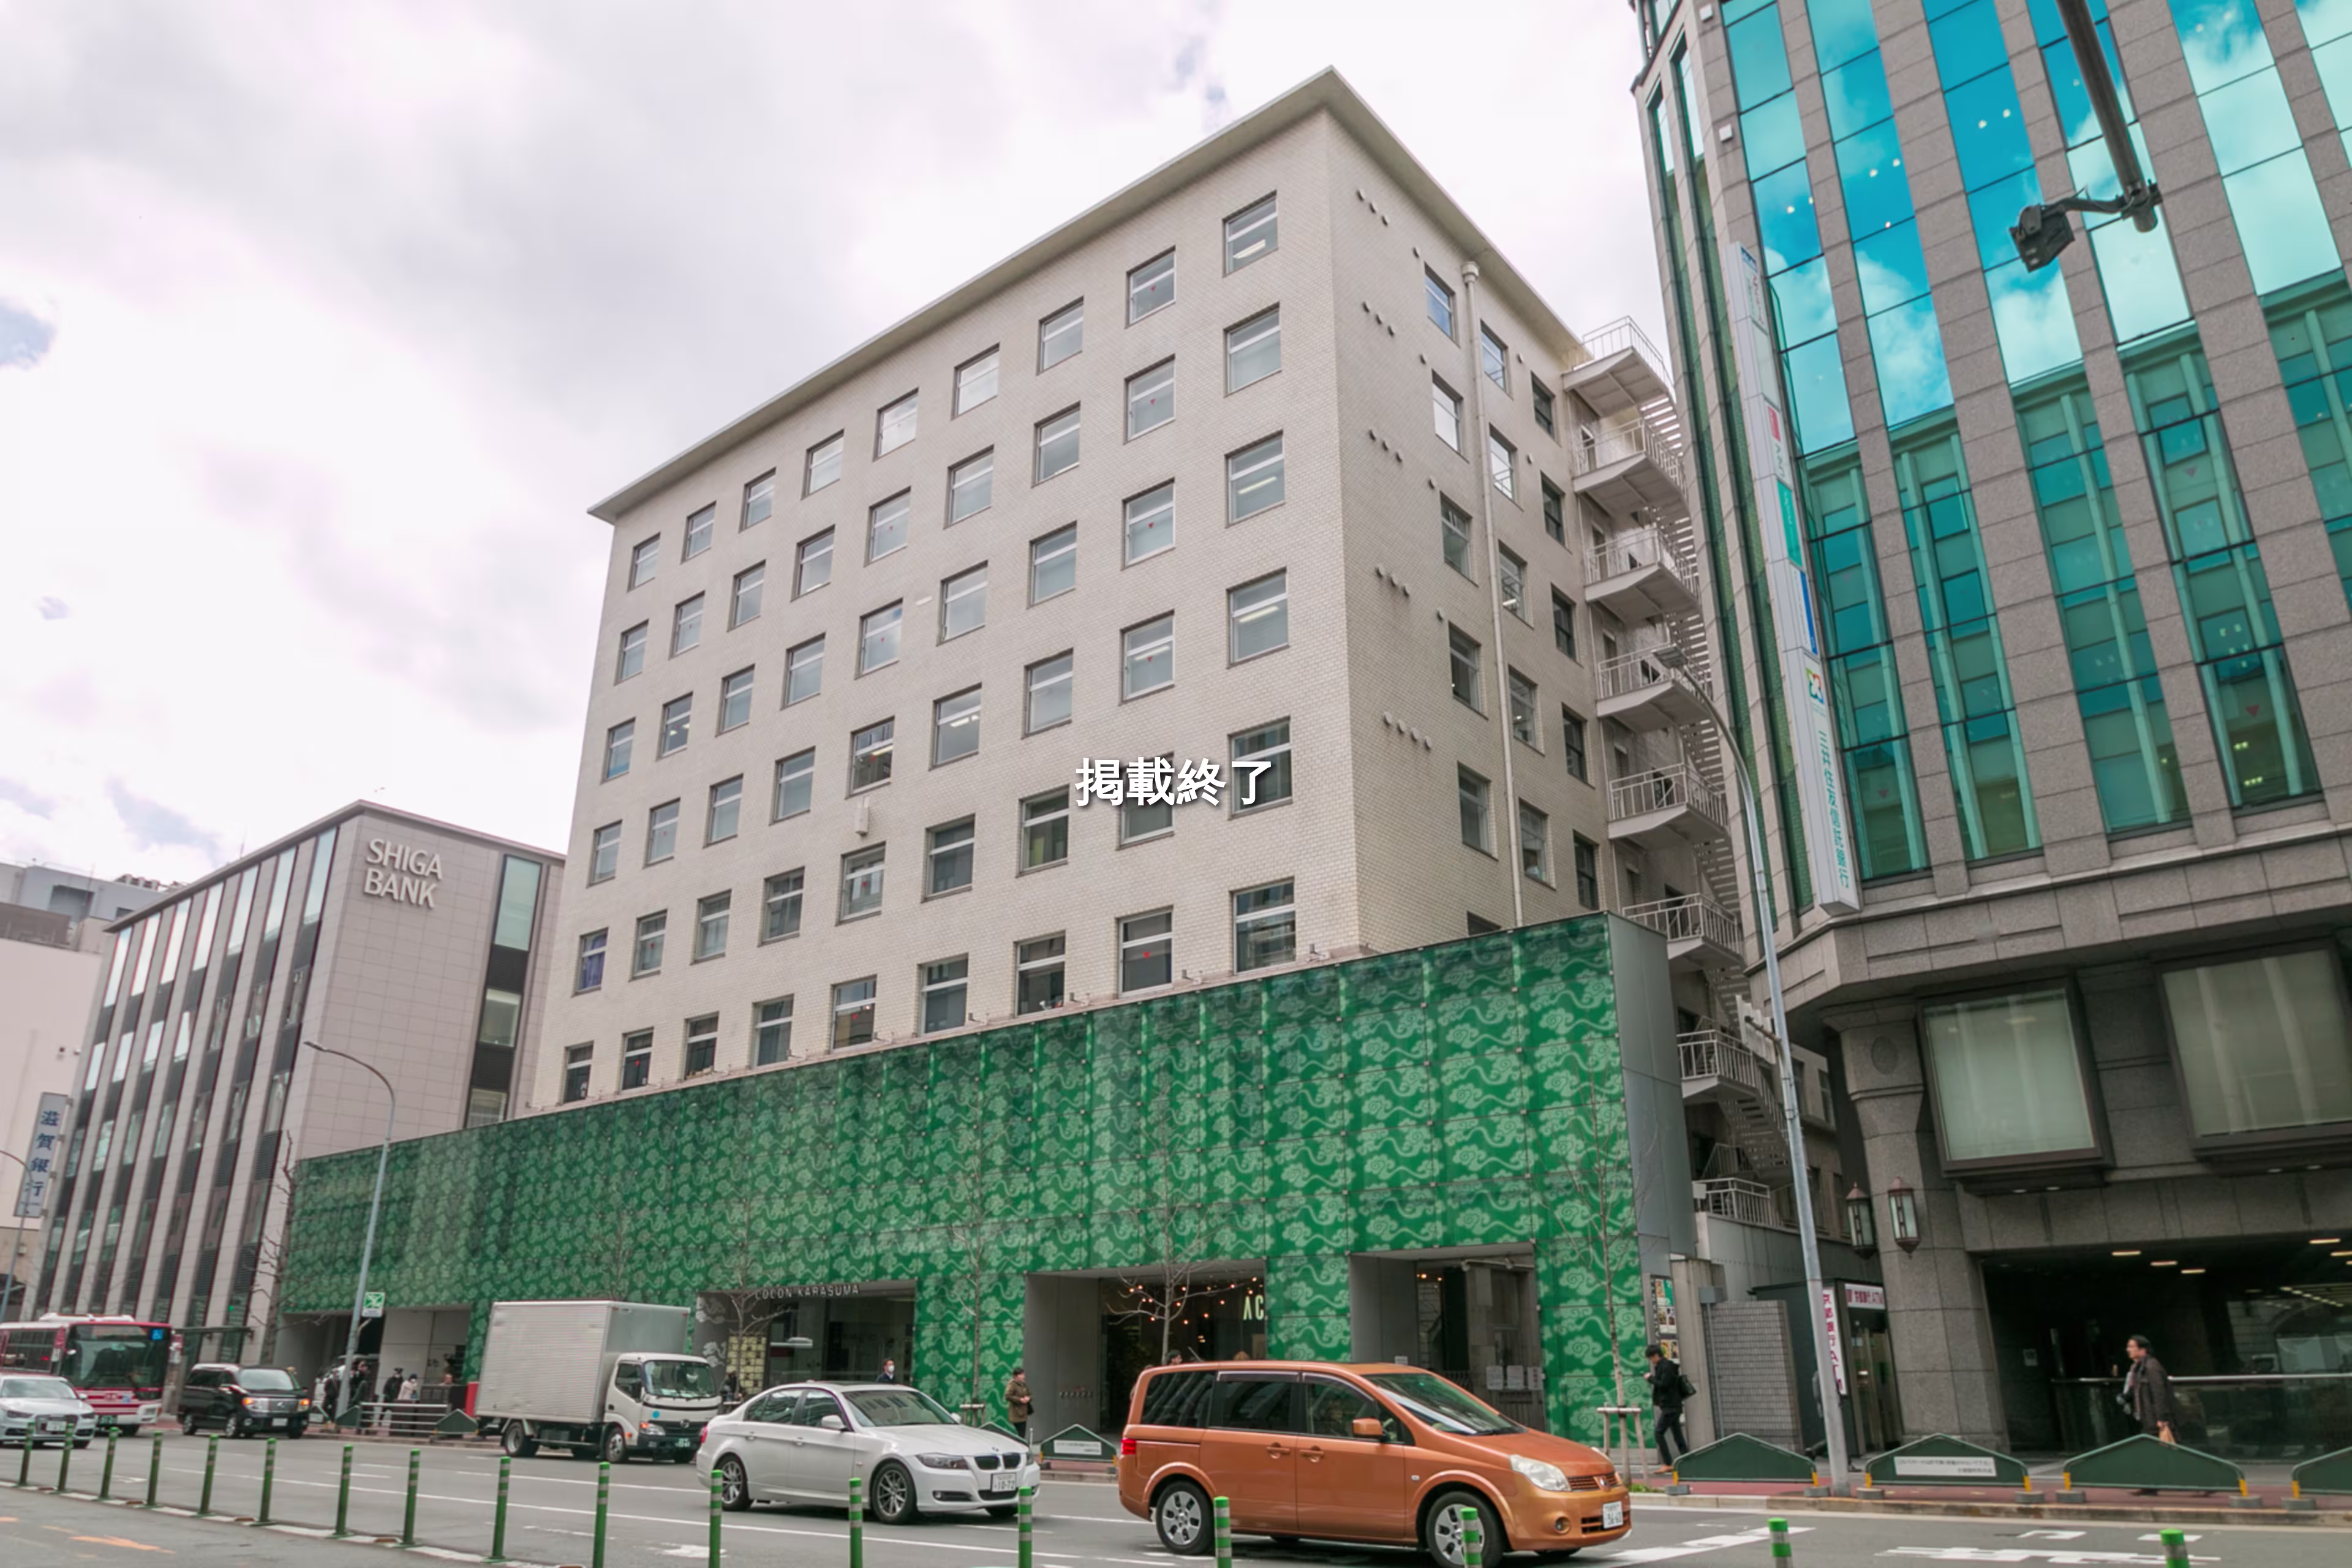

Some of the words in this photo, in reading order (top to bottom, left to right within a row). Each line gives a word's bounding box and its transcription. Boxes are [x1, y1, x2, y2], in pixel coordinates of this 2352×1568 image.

[1818, 730, 1849, 889] 三井住友信託銀行
[366, 838, 442, 880] SHIGA
[364, 867, 437, 908] BANK
[24, 1110, 60, 1197] 滋賀銀行
[755, 1288, 792, 1300] COCON
[797, 1284, 859, 1297] KARASUMA
